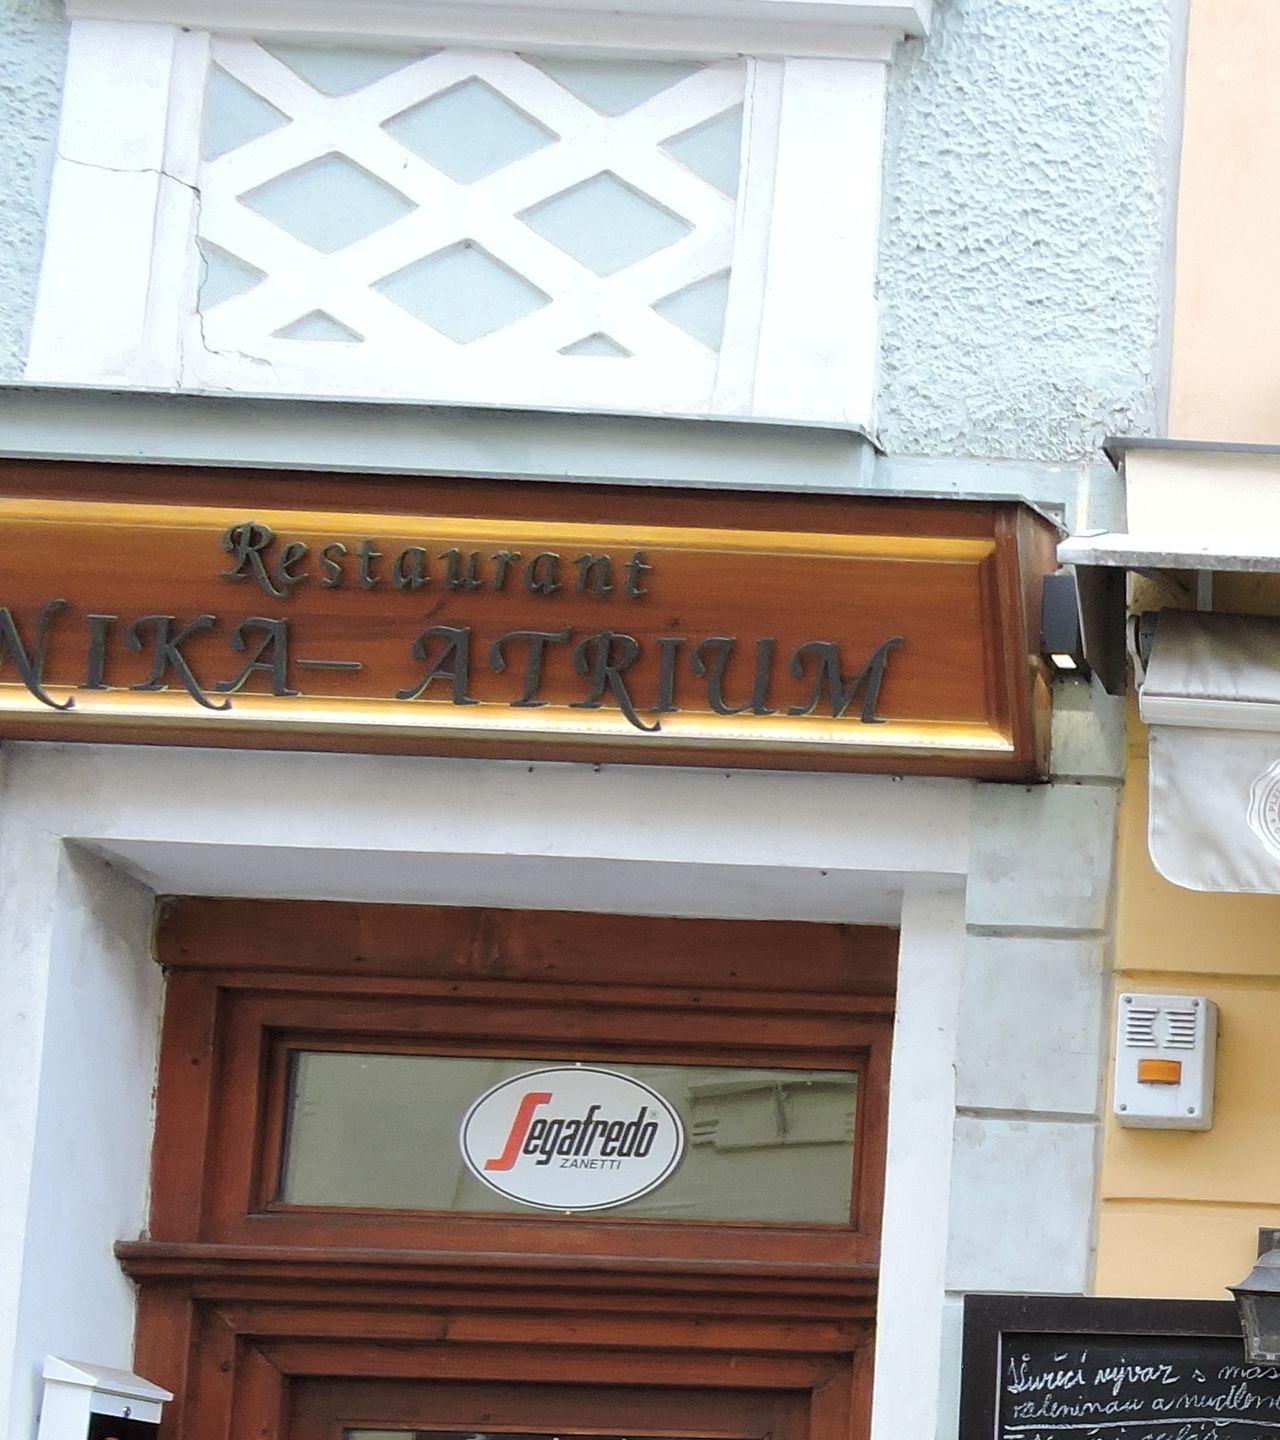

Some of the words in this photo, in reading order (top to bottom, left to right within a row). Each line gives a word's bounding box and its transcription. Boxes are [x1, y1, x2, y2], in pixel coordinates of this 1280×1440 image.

[219, 520, 656, 601] Restaurant
[397, 624, 904, 732] ATRIUM
[484, 1092, 659, 1171] Segafredo
[559, 1157, 622, 1170] ZANETTI
